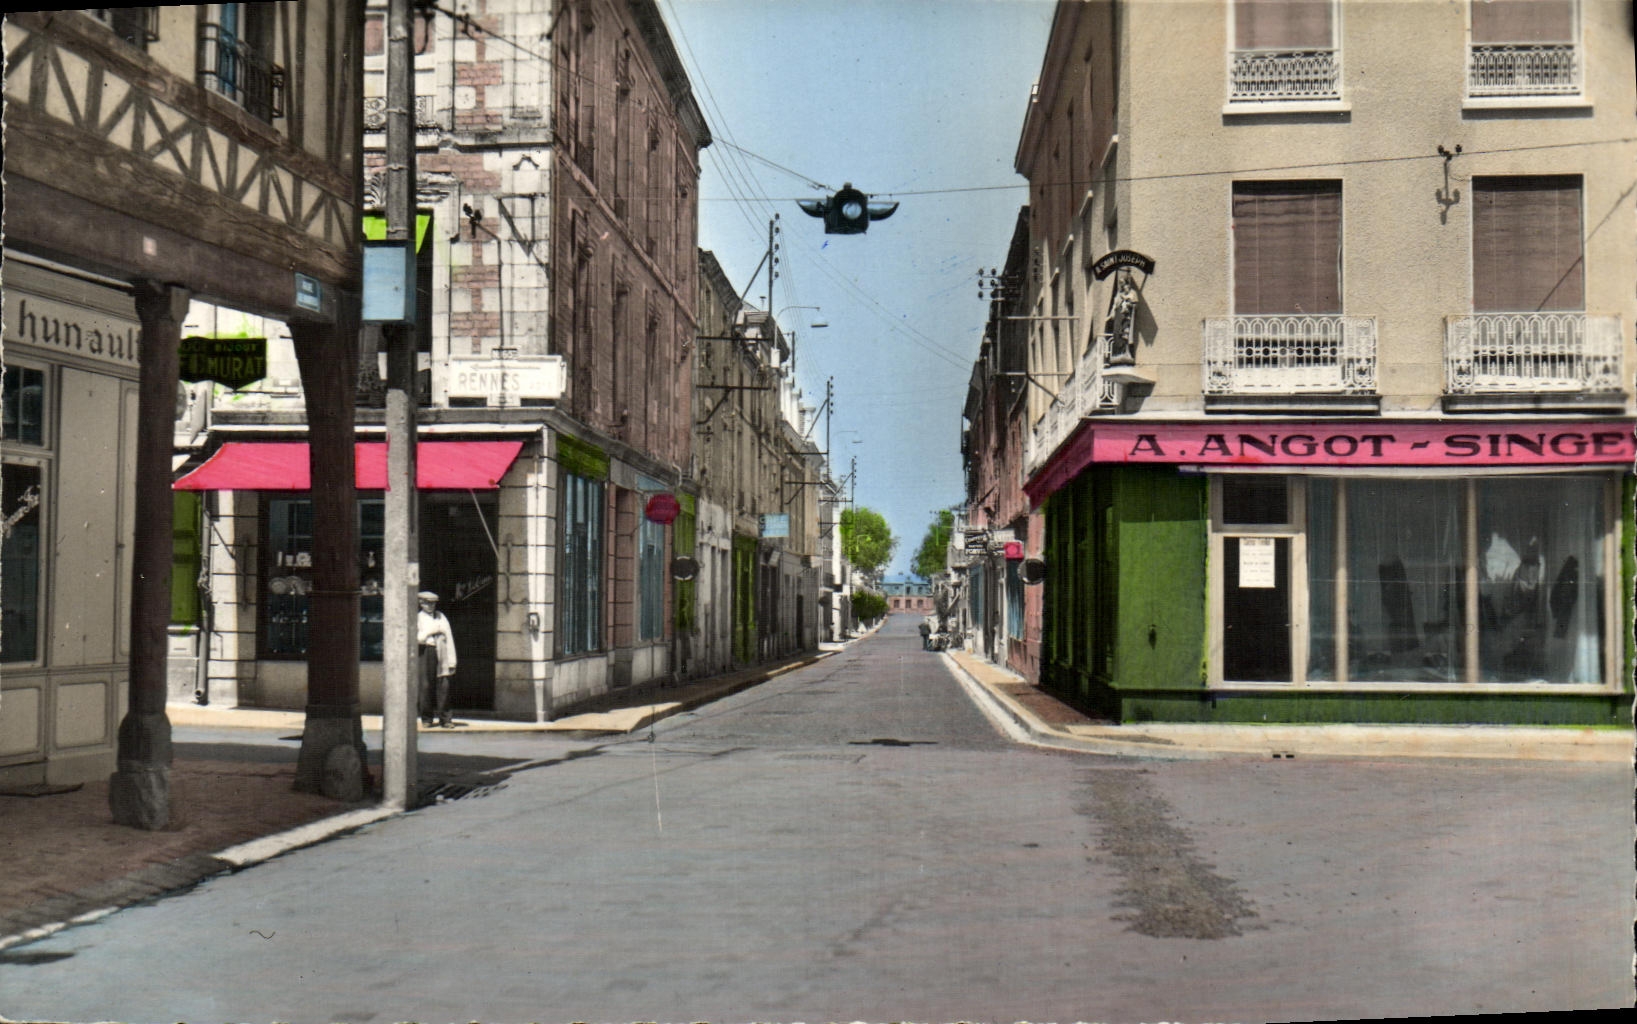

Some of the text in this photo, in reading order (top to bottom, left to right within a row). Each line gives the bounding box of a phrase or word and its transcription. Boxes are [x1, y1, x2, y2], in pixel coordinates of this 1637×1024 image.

[207, 356, 264, 378] MURAT
[458, 372, 520, 391] RENNES
[1444, 432, 1637, 457] SINGE
